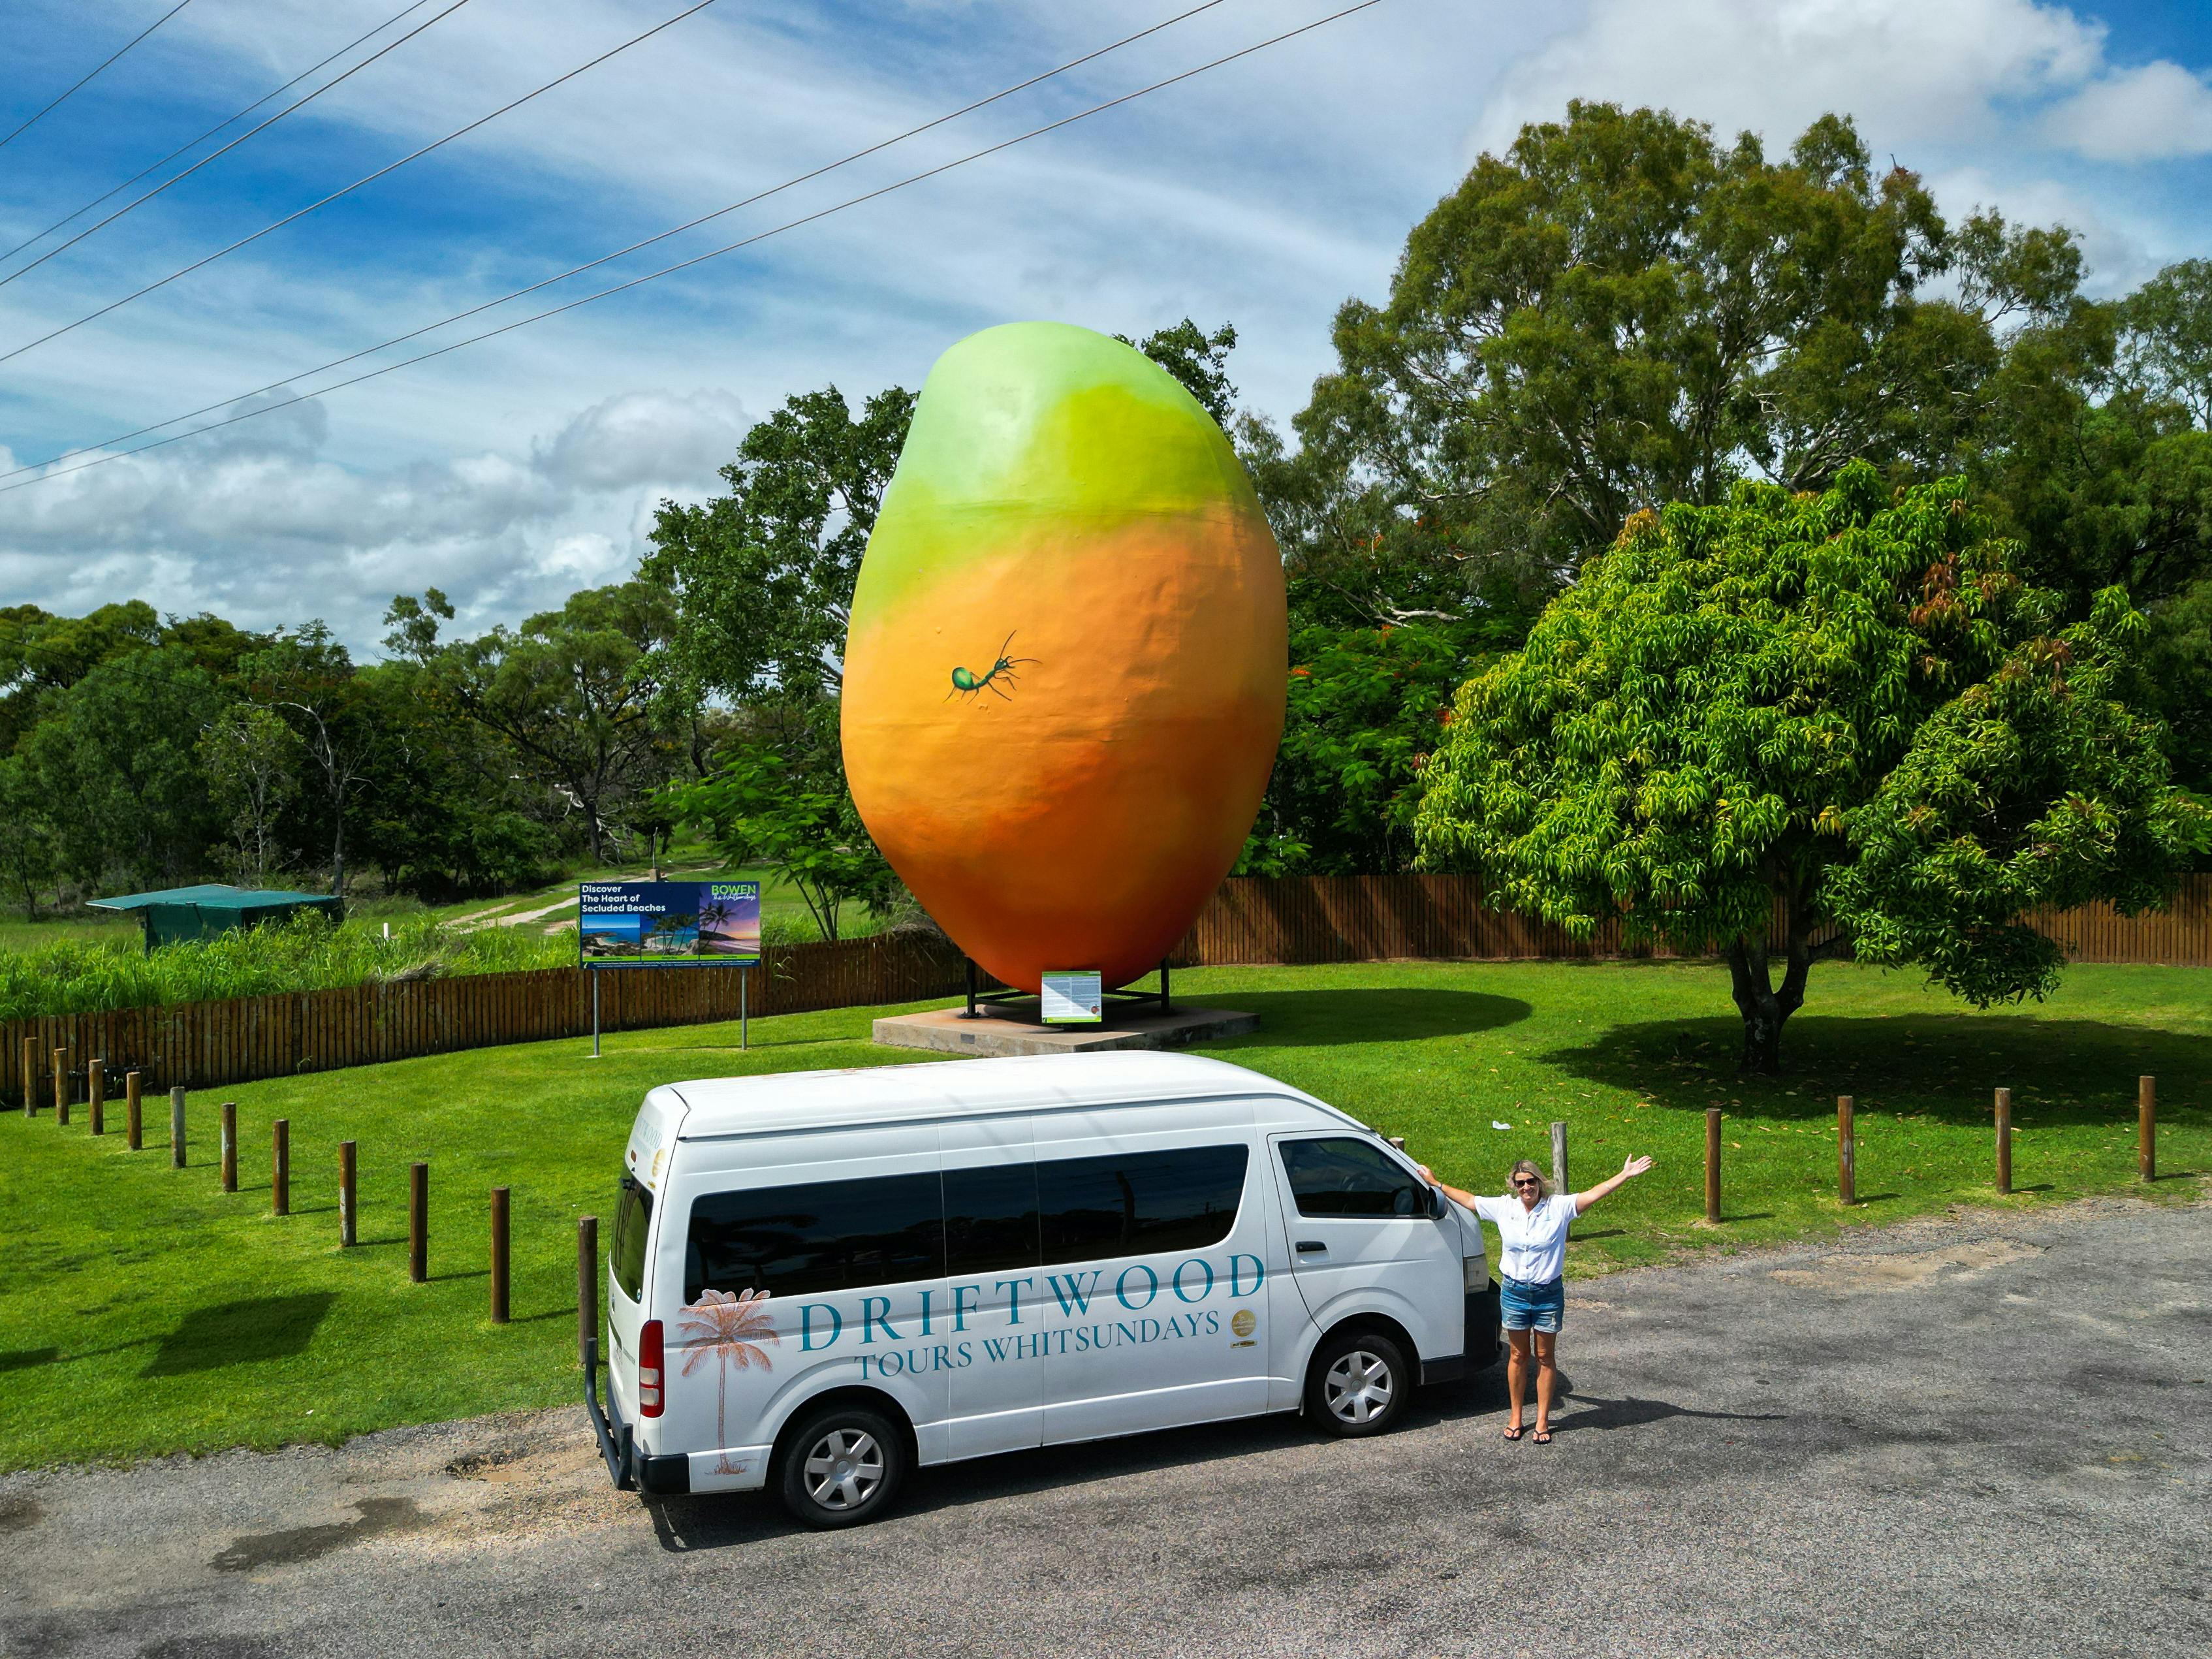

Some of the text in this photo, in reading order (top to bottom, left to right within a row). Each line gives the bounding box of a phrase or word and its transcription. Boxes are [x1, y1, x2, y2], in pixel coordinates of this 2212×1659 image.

[711, 885, 756, 894] BOWEN
[629, 894, 640, 902] of
[582, 904, 625, 912] Secluded
[797, 1253, 1265, 1353] DRIFTWOOD
[854, 1340, 973, 1381] TOURS
[982, 1310, 1220, 1363] WHITSUNDAYS
